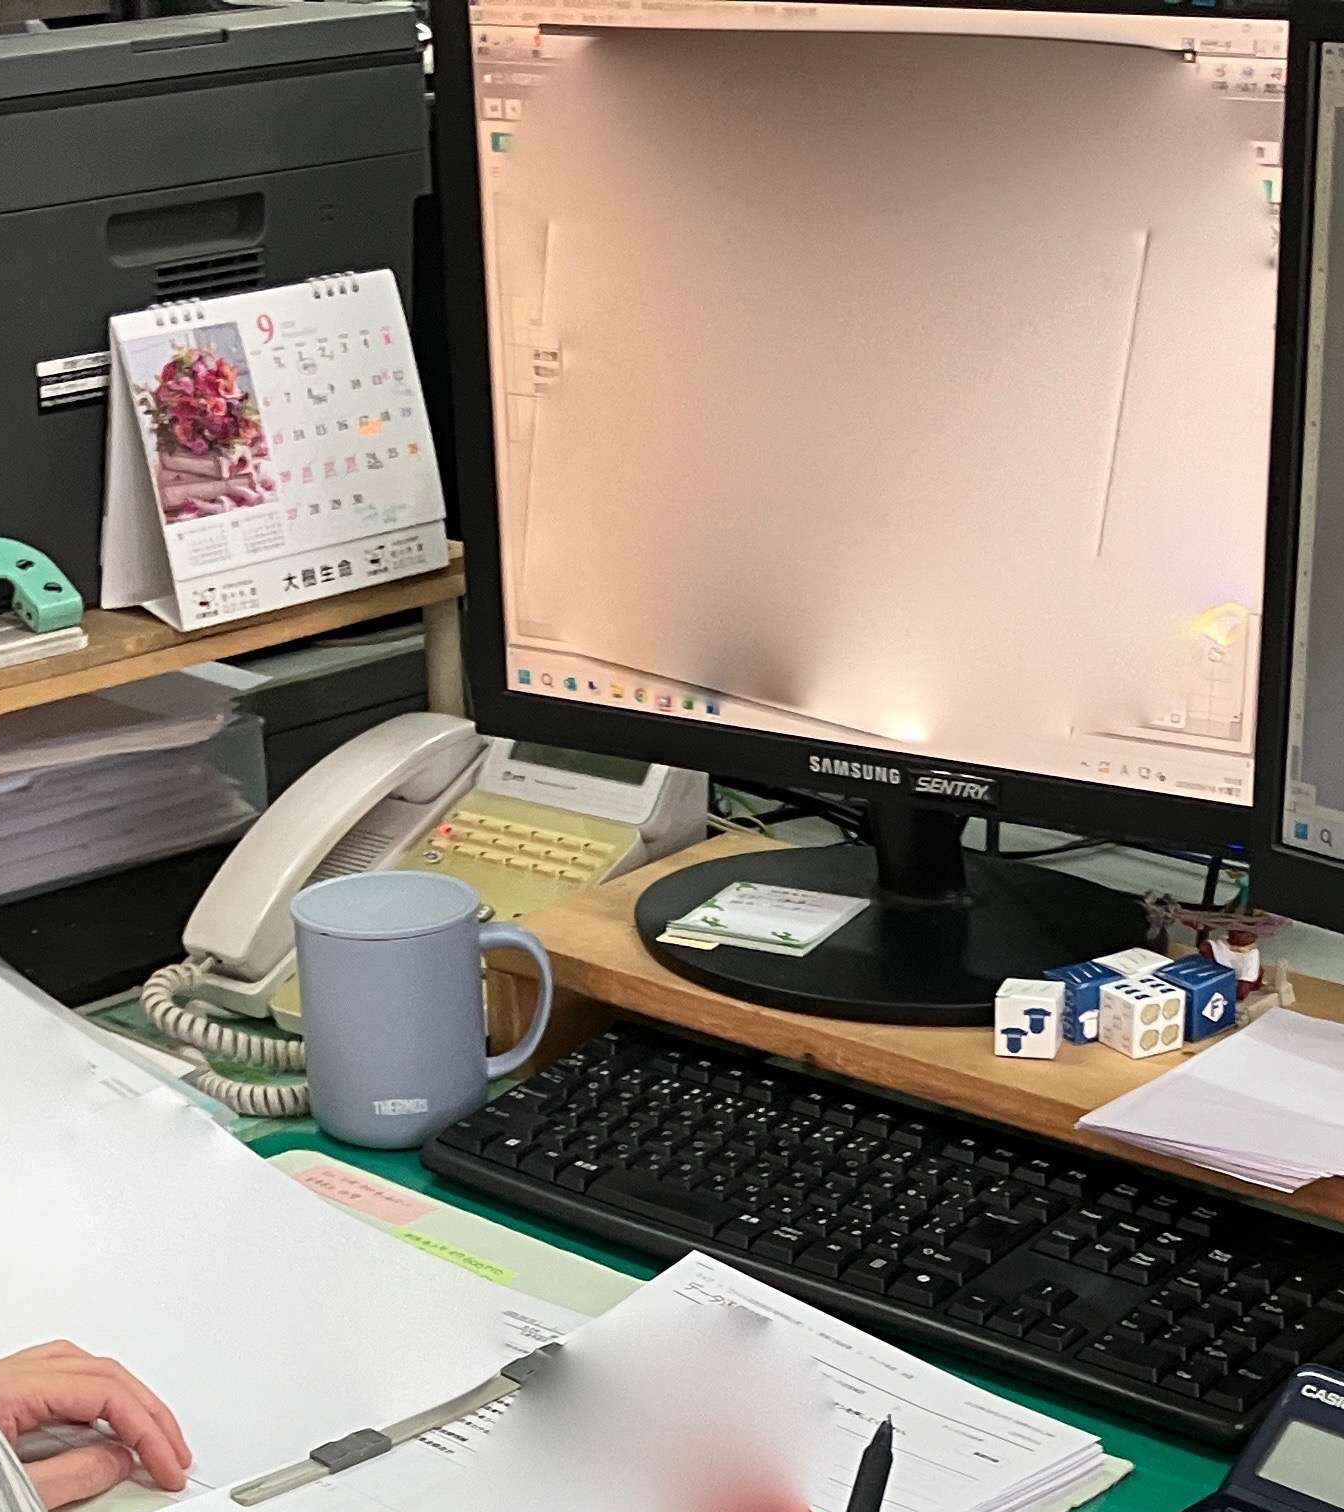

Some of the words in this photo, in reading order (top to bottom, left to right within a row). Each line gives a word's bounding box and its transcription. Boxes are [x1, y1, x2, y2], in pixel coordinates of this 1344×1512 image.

[256, 314, 274, 344] 9
[809, 755, 902, 784] SAMSUNG
[915, 776, 990, 800] SENTRY
[372, 1098, 428, 1116] THERMOS
